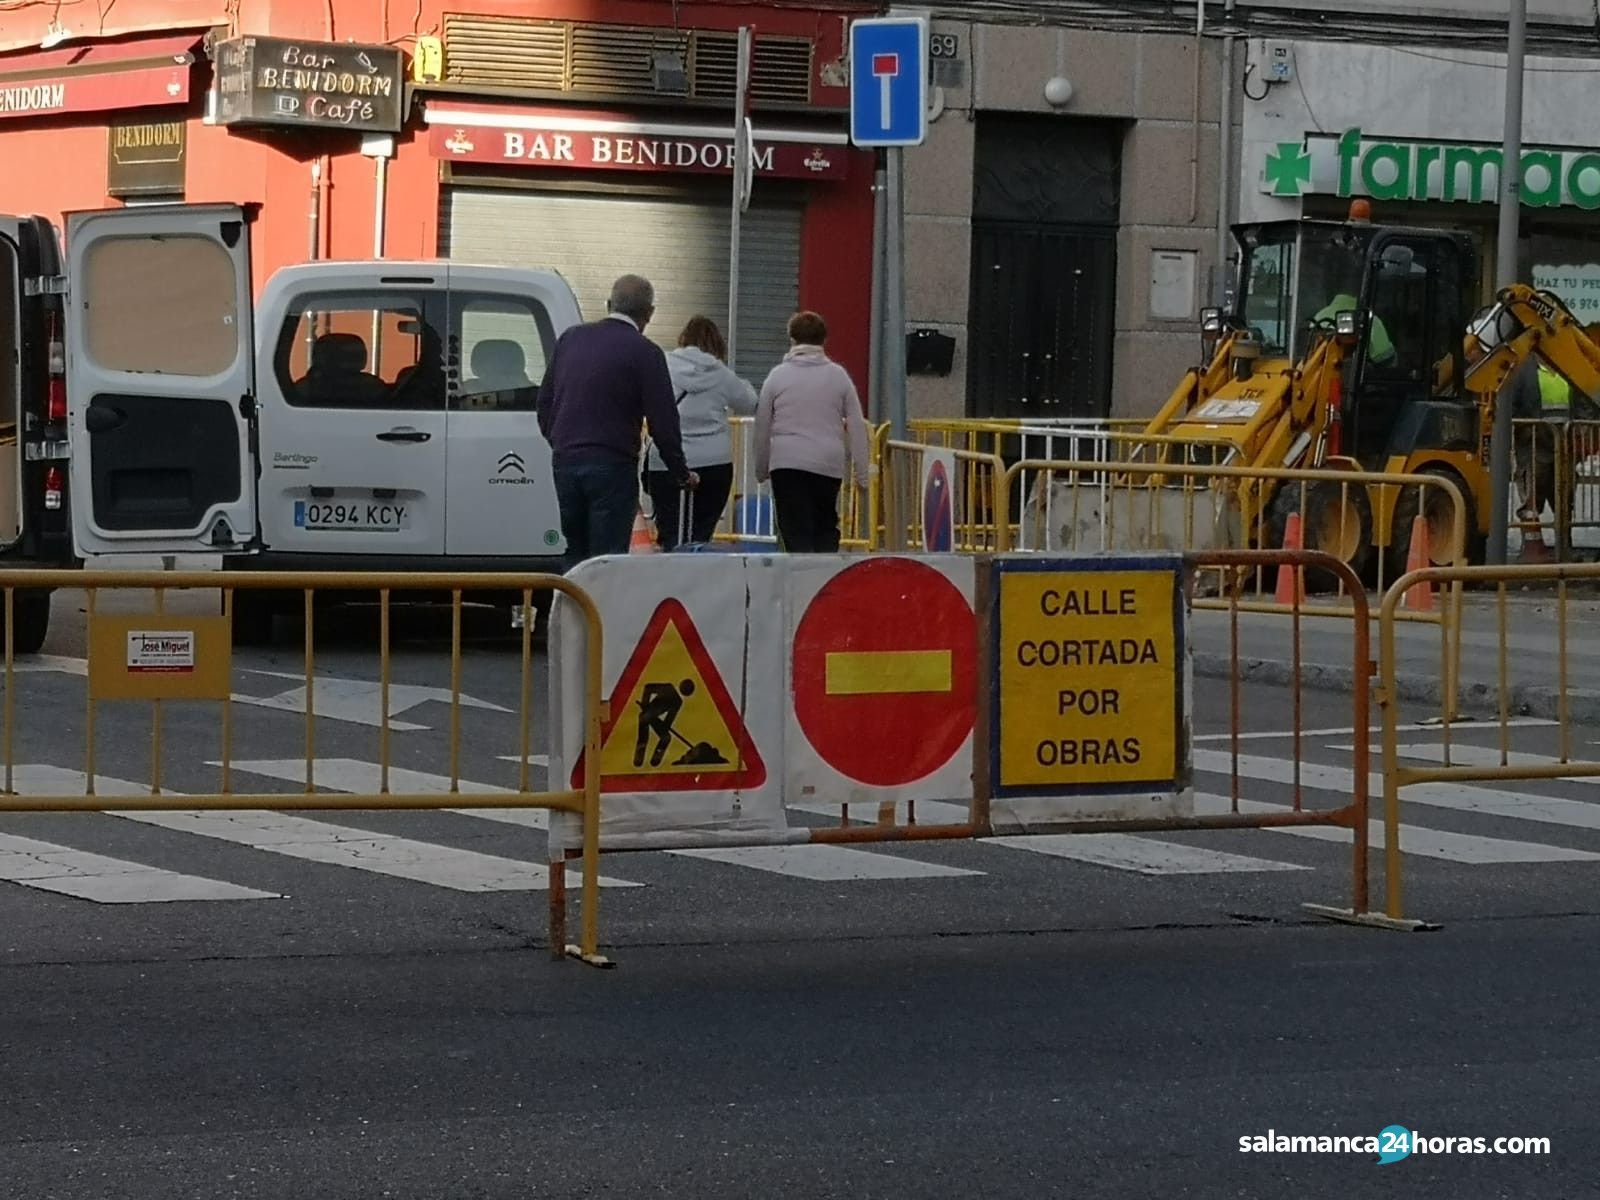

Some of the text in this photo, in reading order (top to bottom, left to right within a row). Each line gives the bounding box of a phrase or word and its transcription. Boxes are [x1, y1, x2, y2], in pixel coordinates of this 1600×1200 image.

[283, 45, 336, 69] Bar
[931, 35, 955, 56] 69
[264, 67, 392, 97] BENIDORM
[310, 97, 374, 124] Café
[117, 122, 180, 148] BENIDORM
[503, 132, 575, 161] BAR
[1536, 278, 1559, 288] HAZ
[1563, 278, 1577, 288] TU
[273, 452, 319, 464] Berlingo
[308, 505, 404, 524] 0294 KCY
[1041, 589, 1136, 616] CALLE
[161, 640, 190, 652] Miguel
[1017, 639, 1158, 667] CORTADA
[1058, 689, 1119, 715] POR
[1036, 738, 1140, 766] OBRAS
